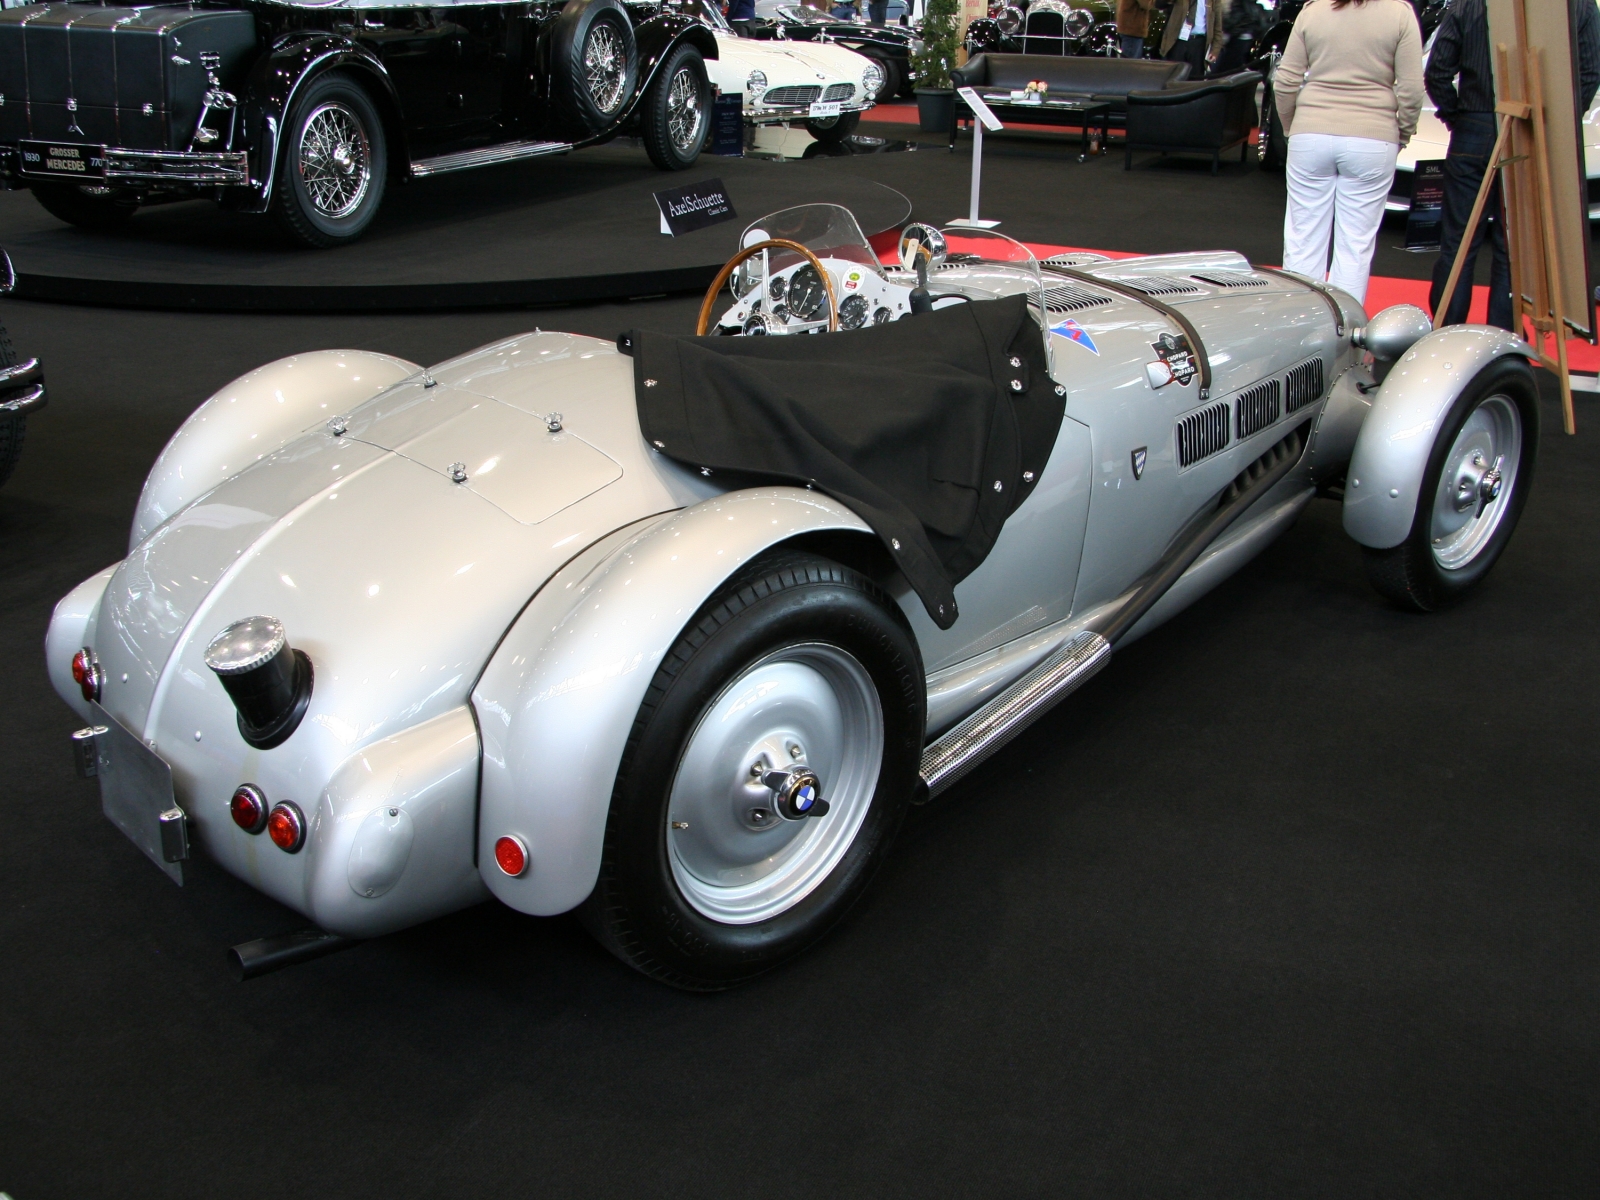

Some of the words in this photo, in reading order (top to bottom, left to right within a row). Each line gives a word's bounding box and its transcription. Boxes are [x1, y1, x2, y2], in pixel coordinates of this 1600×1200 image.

[24, 152, 41, 162] 1930
[49, 147, 80, 158] GROSSER
[46, 158, 86, 171] MERCEDES
[90, 157, 103, 167] 770
[1425, 165, 1441, 174] SML
[668, 193, 725, 218] AxelSchuette
[1166, 351, 1188, 362] CHOPARD
[1174, 366, 1195, 377] HOPARD
